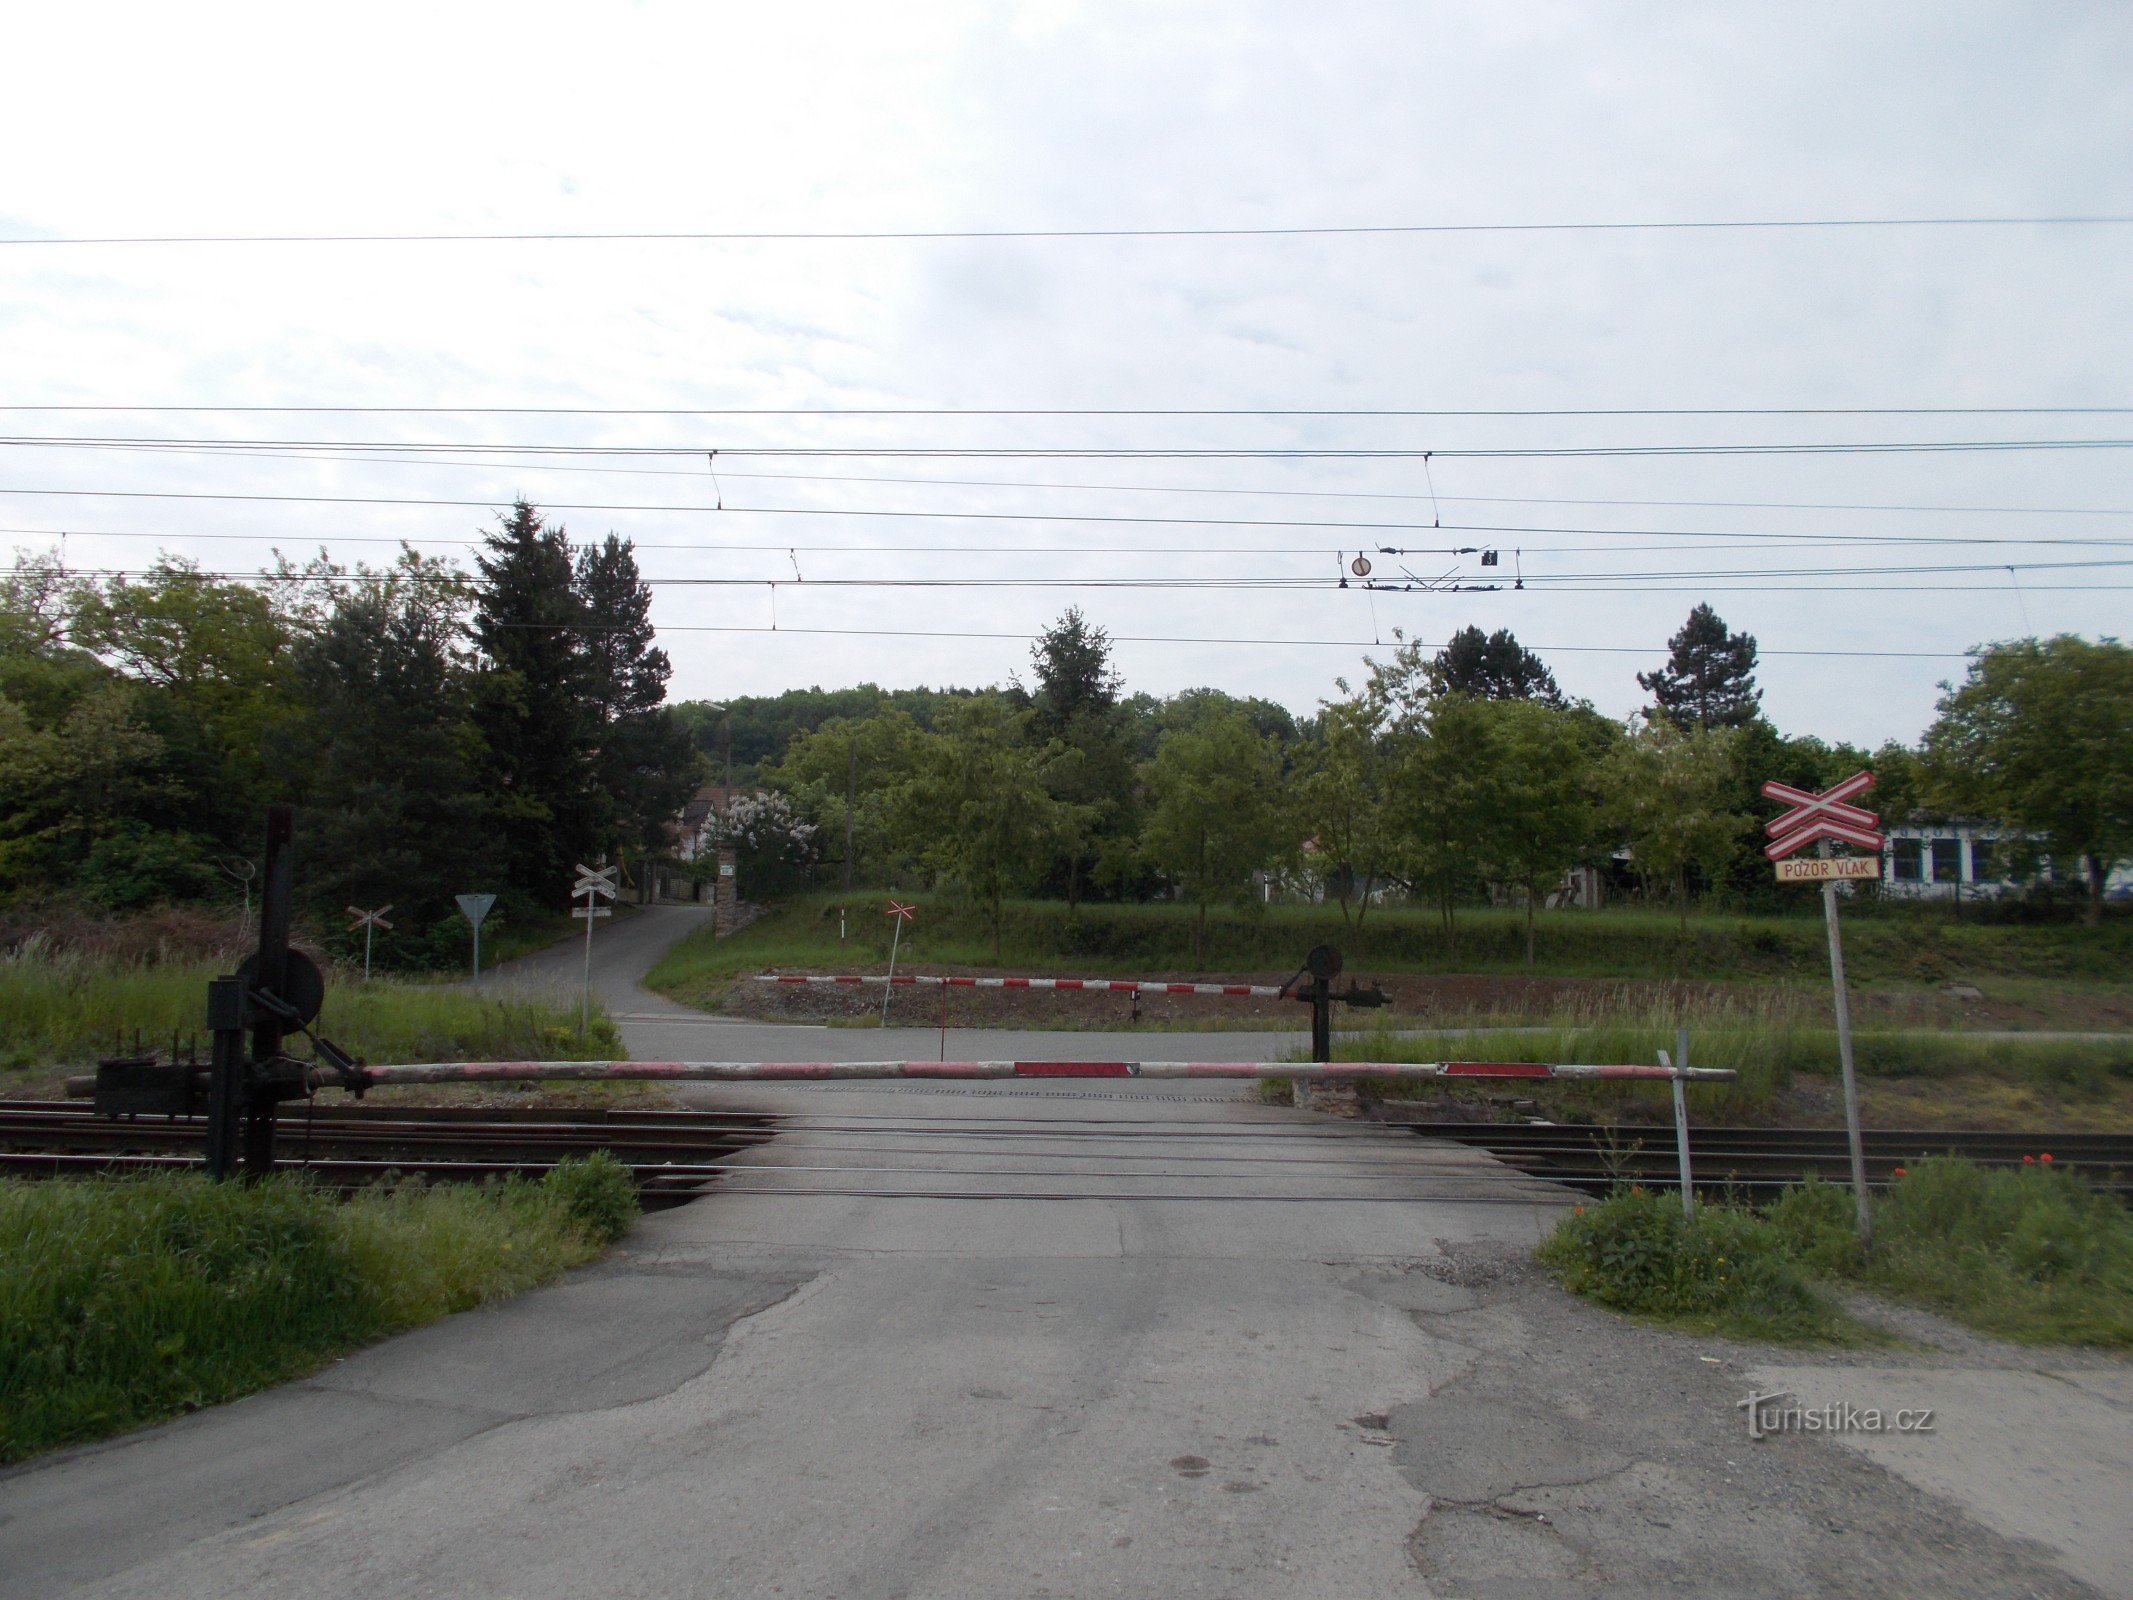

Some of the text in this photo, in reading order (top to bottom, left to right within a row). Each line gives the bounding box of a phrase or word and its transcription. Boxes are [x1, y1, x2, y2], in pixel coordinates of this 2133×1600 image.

[1486, 554, 1493, 565] 3
[1785, 861, 1869, 877] POZOR VLAK
